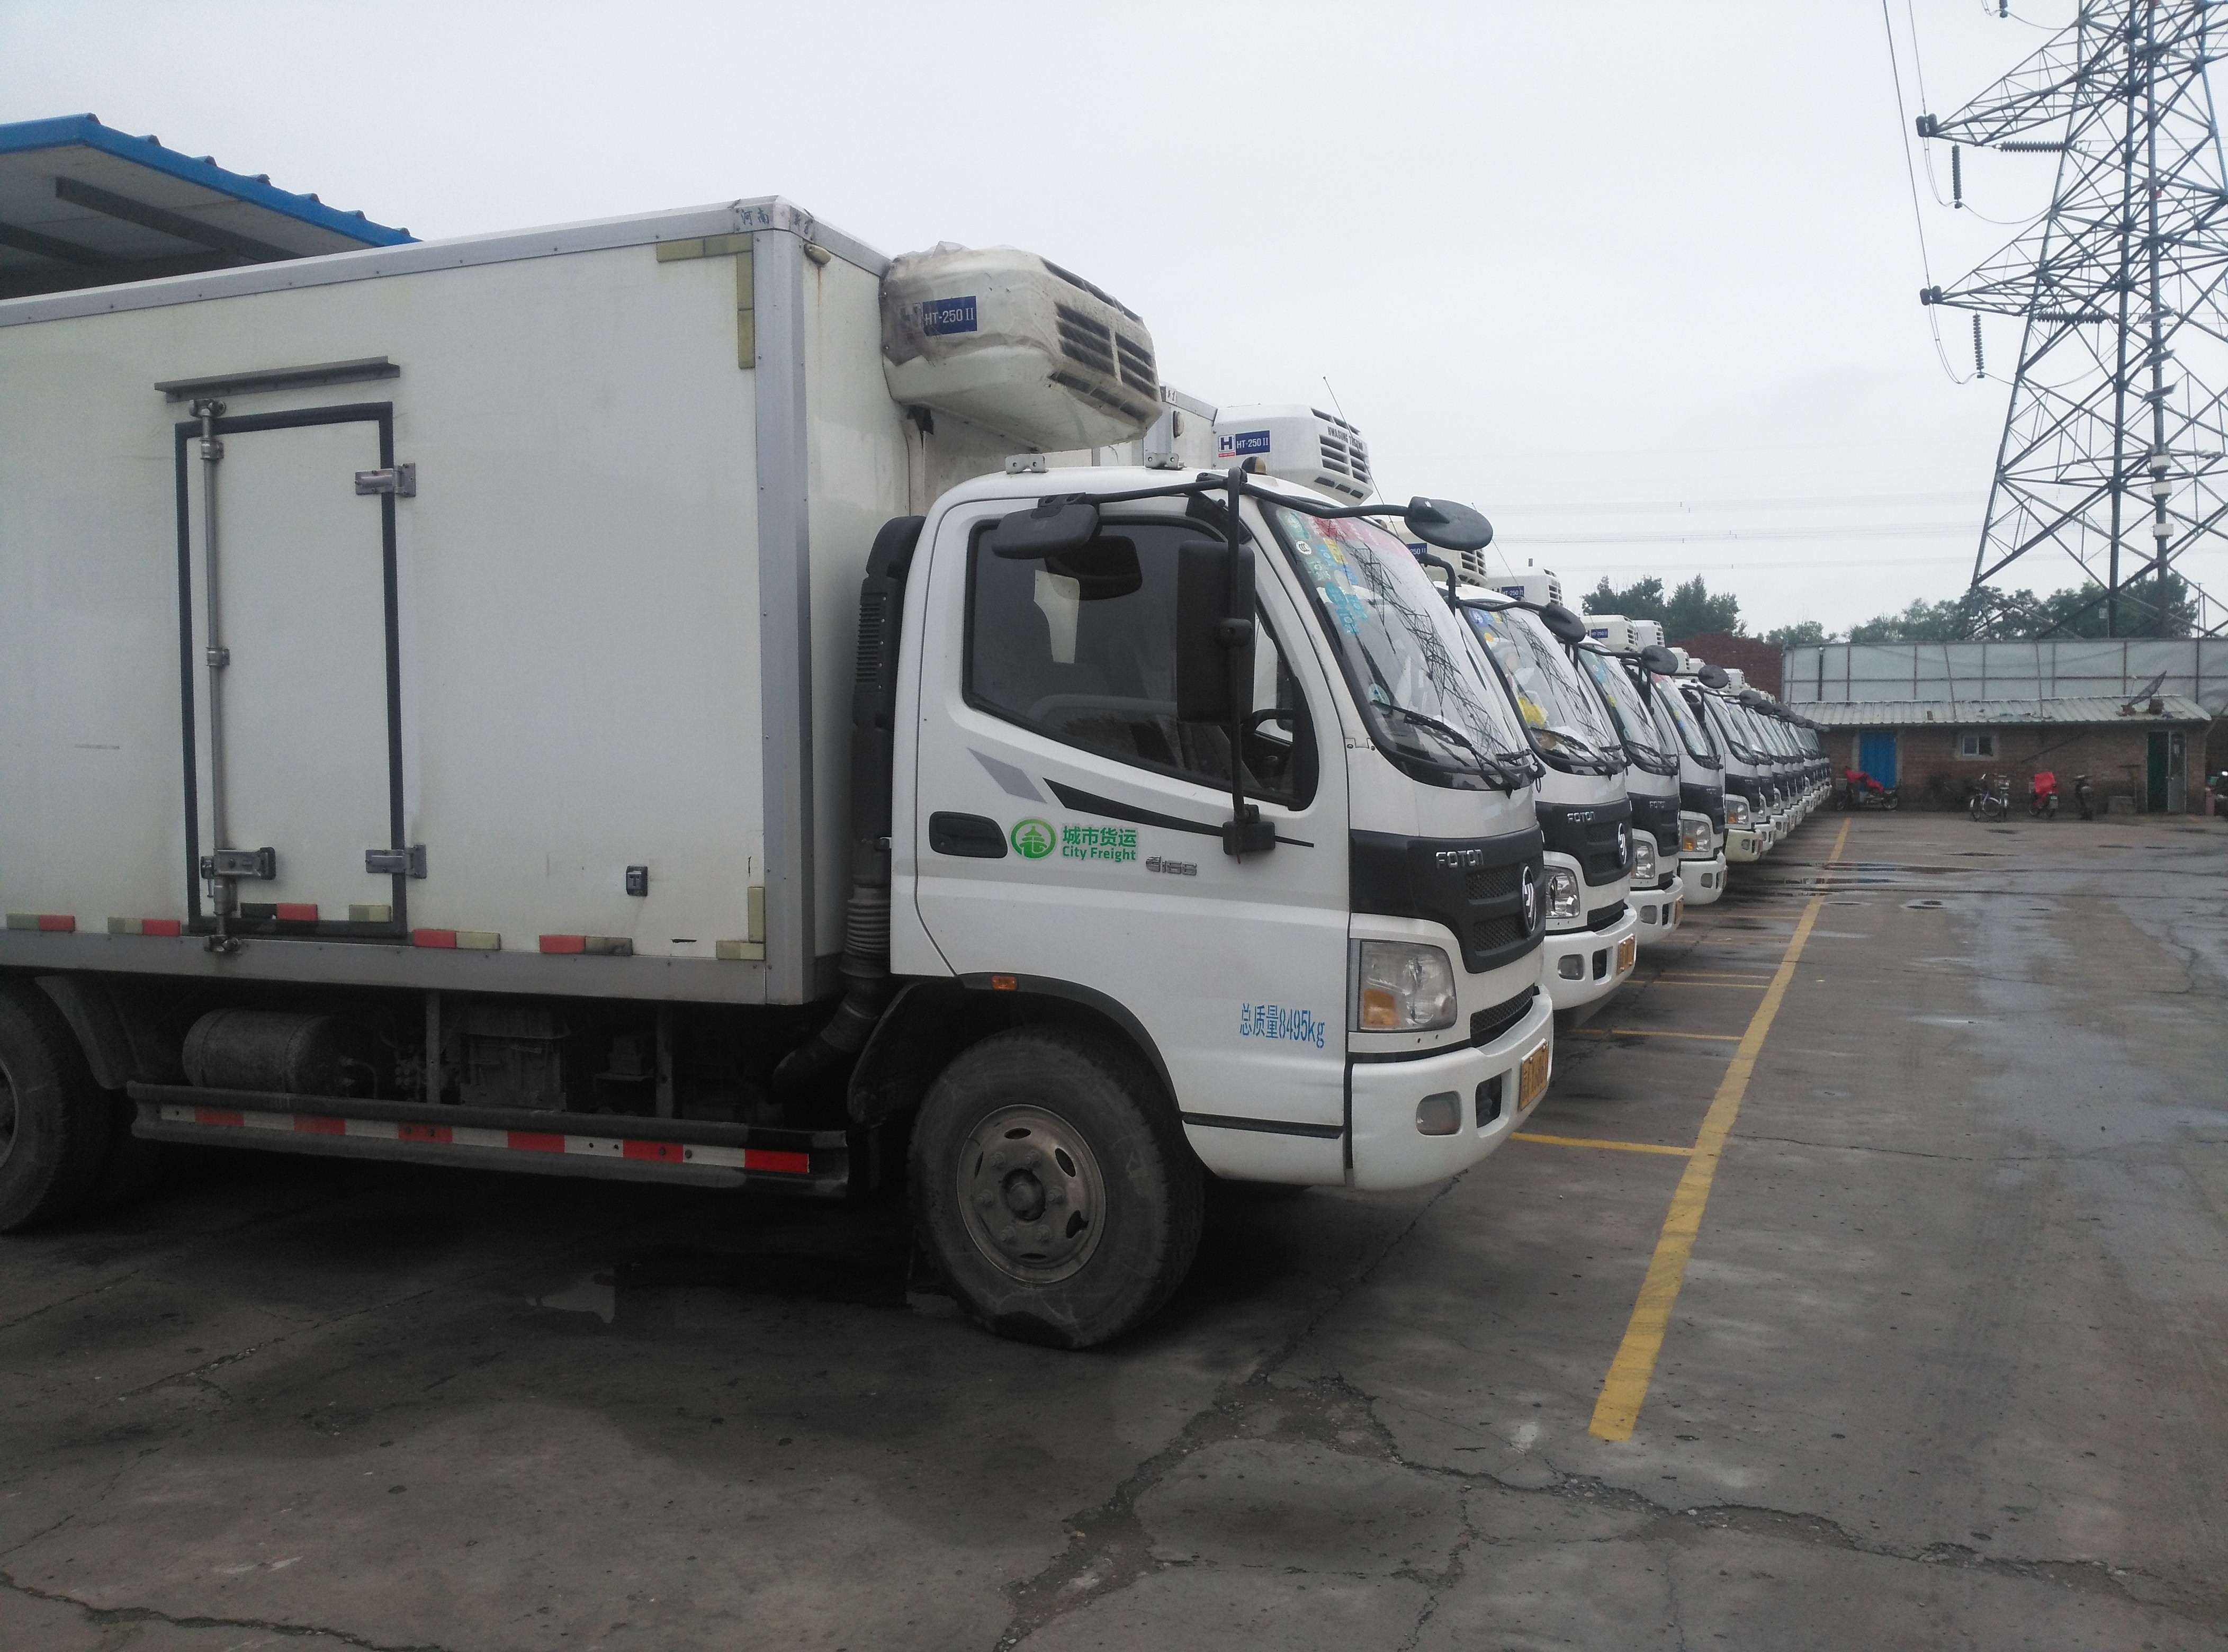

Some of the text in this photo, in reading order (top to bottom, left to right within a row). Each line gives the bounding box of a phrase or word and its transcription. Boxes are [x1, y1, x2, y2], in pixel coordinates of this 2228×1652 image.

[925, 309, 963, 326] HT-250
[1220, 436, 1233, 451] H
[1237, 438, 1261, 448] HT-250
[1567, 811, 1595, 823] FOTON
[1063, 825, 1137, 848] 城市货运
[1062, 846, 1136, 863] City Freight
[1435, 849, 1484, 869] FOTON
[1239, 1002, 1325, 1049] 总质量8495kg
